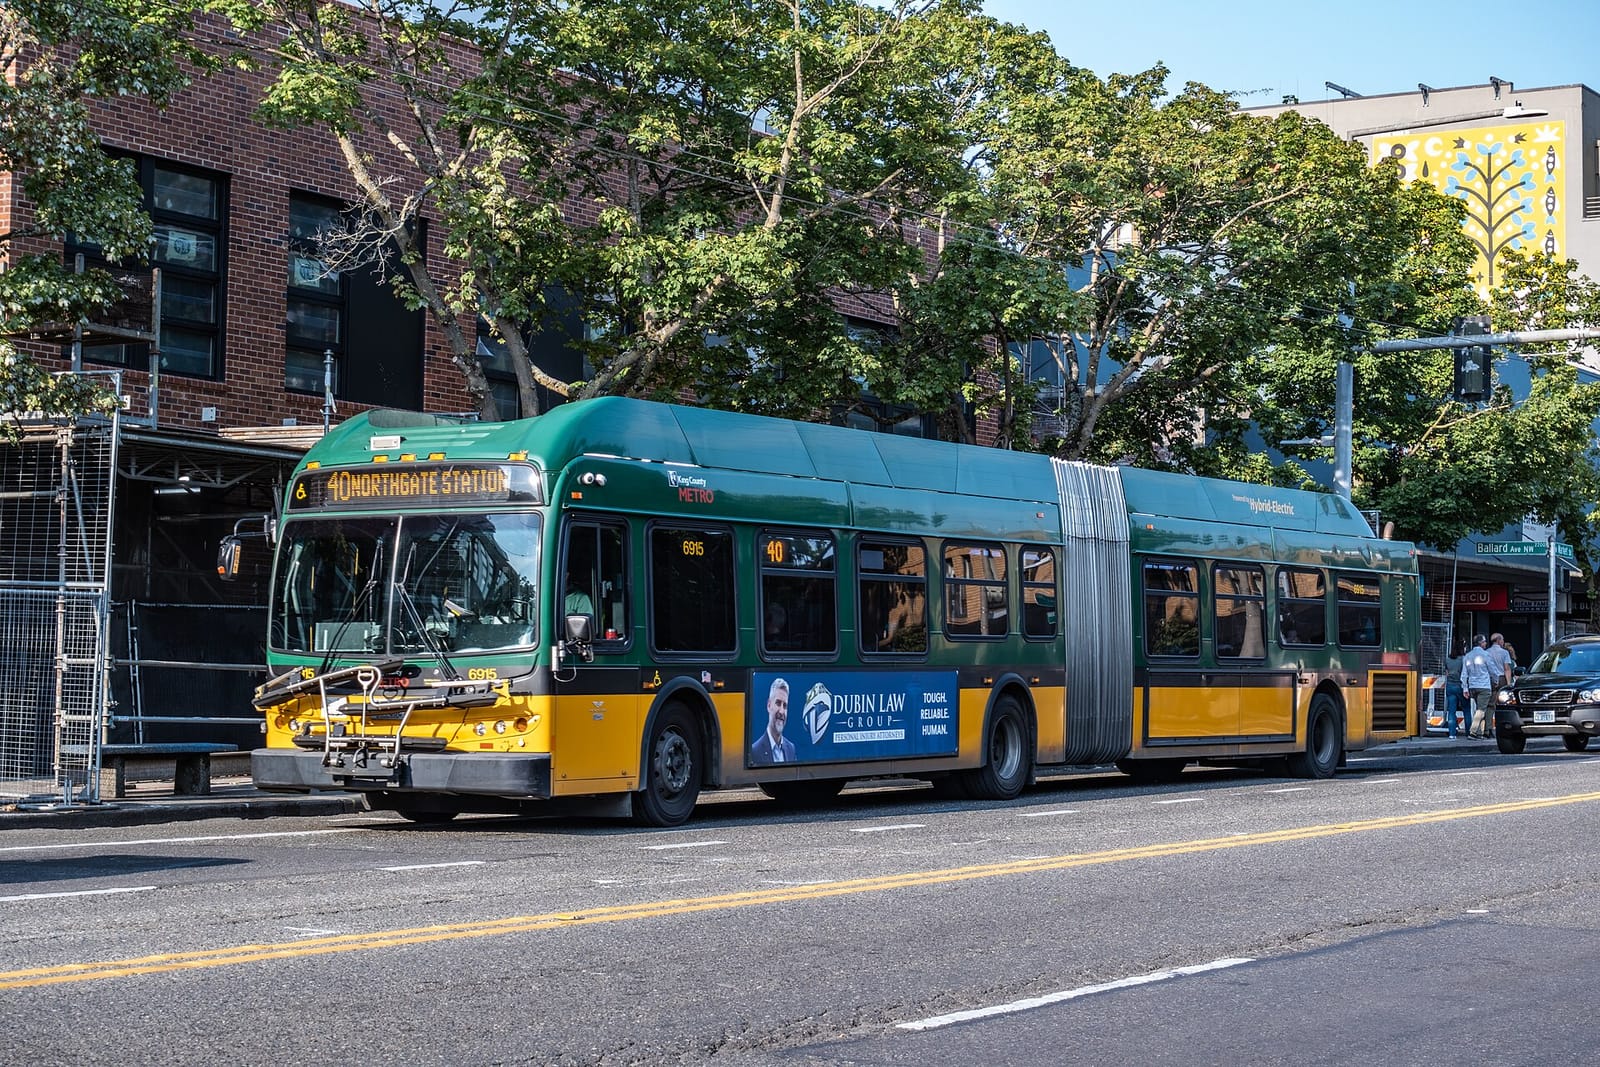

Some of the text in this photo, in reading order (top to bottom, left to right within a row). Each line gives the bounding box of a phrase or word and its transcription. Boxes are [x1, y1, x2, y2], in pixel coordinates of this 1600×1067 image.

[327, 470, 508, 501] 40 NORTHGATE STATION
[678, 475, 706, 488] King County
[678, 487, 714, 504] METRO
[1250, 497, 1294, 515] Hybrid-Electric
[682, 540, 704, 556] 6915
[767, 540, 783, 562] 40
[1477, 543, 1508, 553] Ballard
[1523, 545, 1534, 553] NW
[1454, 592, 1487, 602] ECU
[302, 667, 315, 680] 15
[468, 667, 497, 681] 6915
[833, 693, 905, 715] DUBIN LAW
[923, 692, 948, 704] TOUGH.
[920, 708, 950, 720] RELIABLE.
[847, 715, 893, 728] GROUP
[922, 723, 948, 736] HUMAN.
